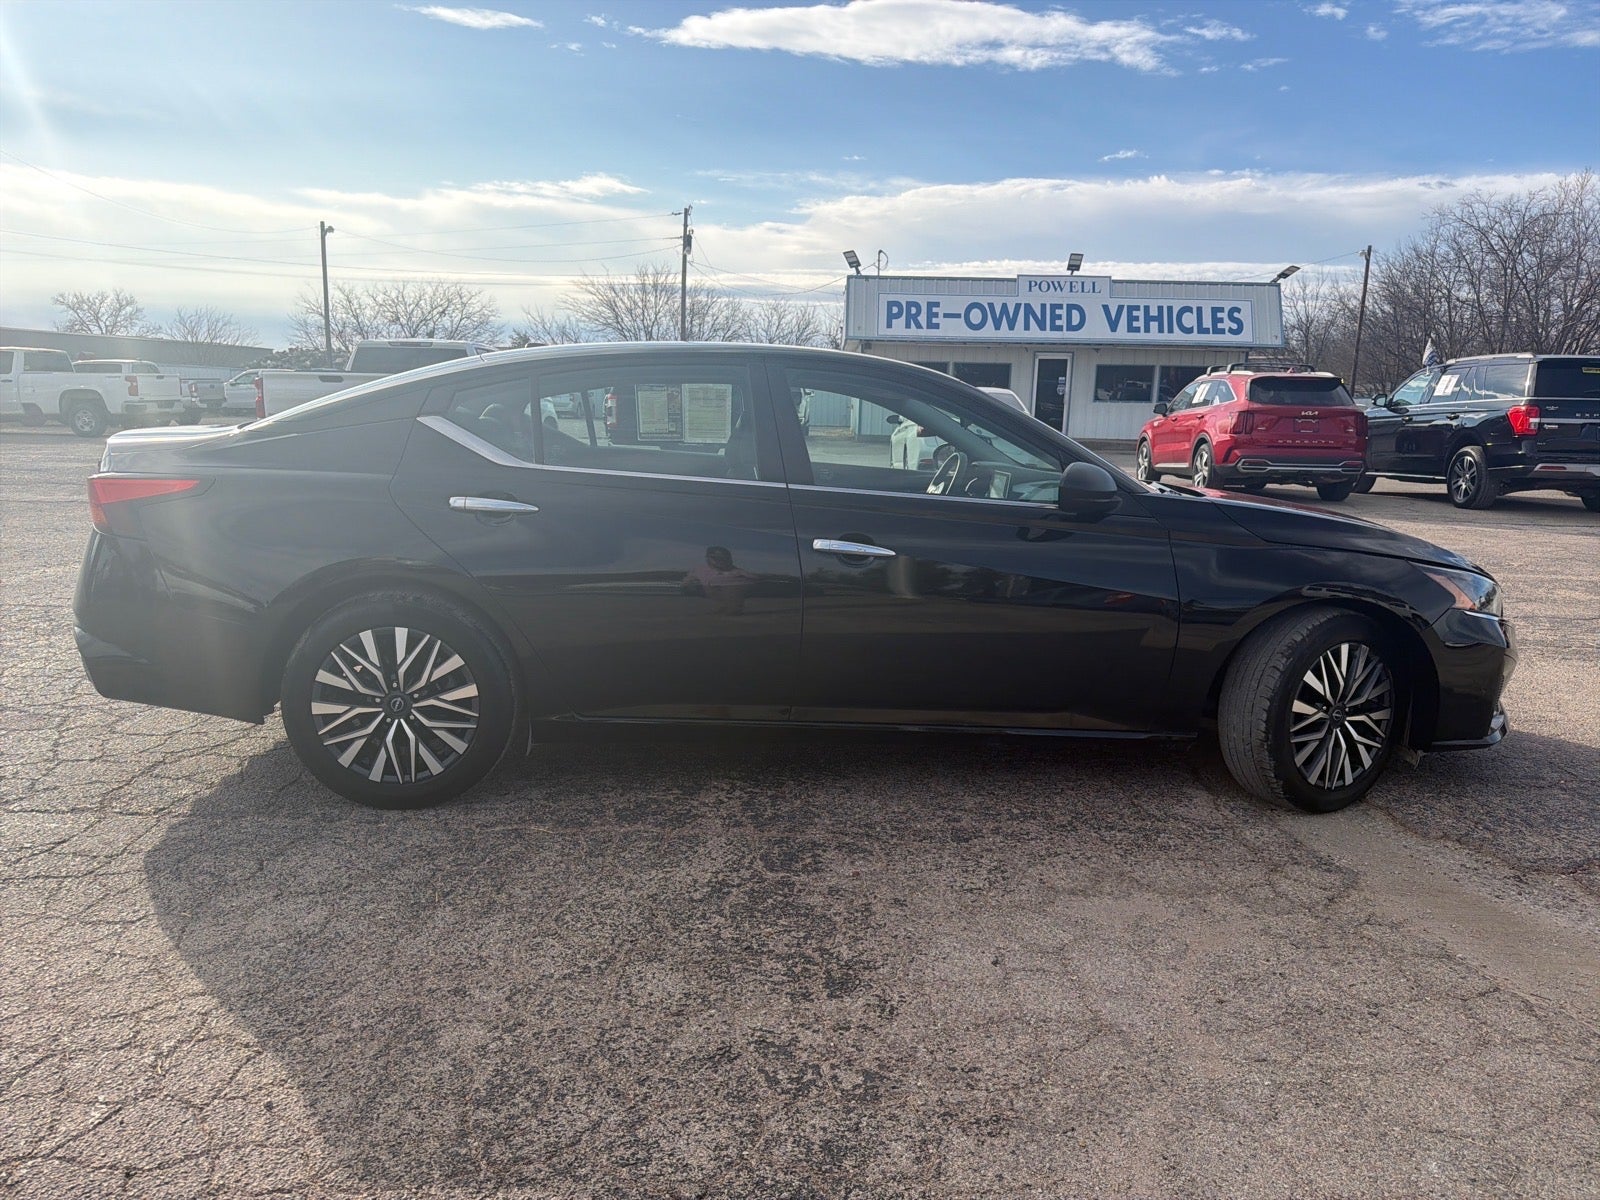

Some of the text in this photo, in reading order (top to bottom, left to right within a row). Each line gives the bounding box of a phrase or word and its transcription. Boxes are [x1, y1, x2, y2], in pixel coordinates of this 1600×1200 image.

[1028, 280, 1102, 294] POWELL
[886, 300, 1244, 336] PRE-OWNED VEHICLES
